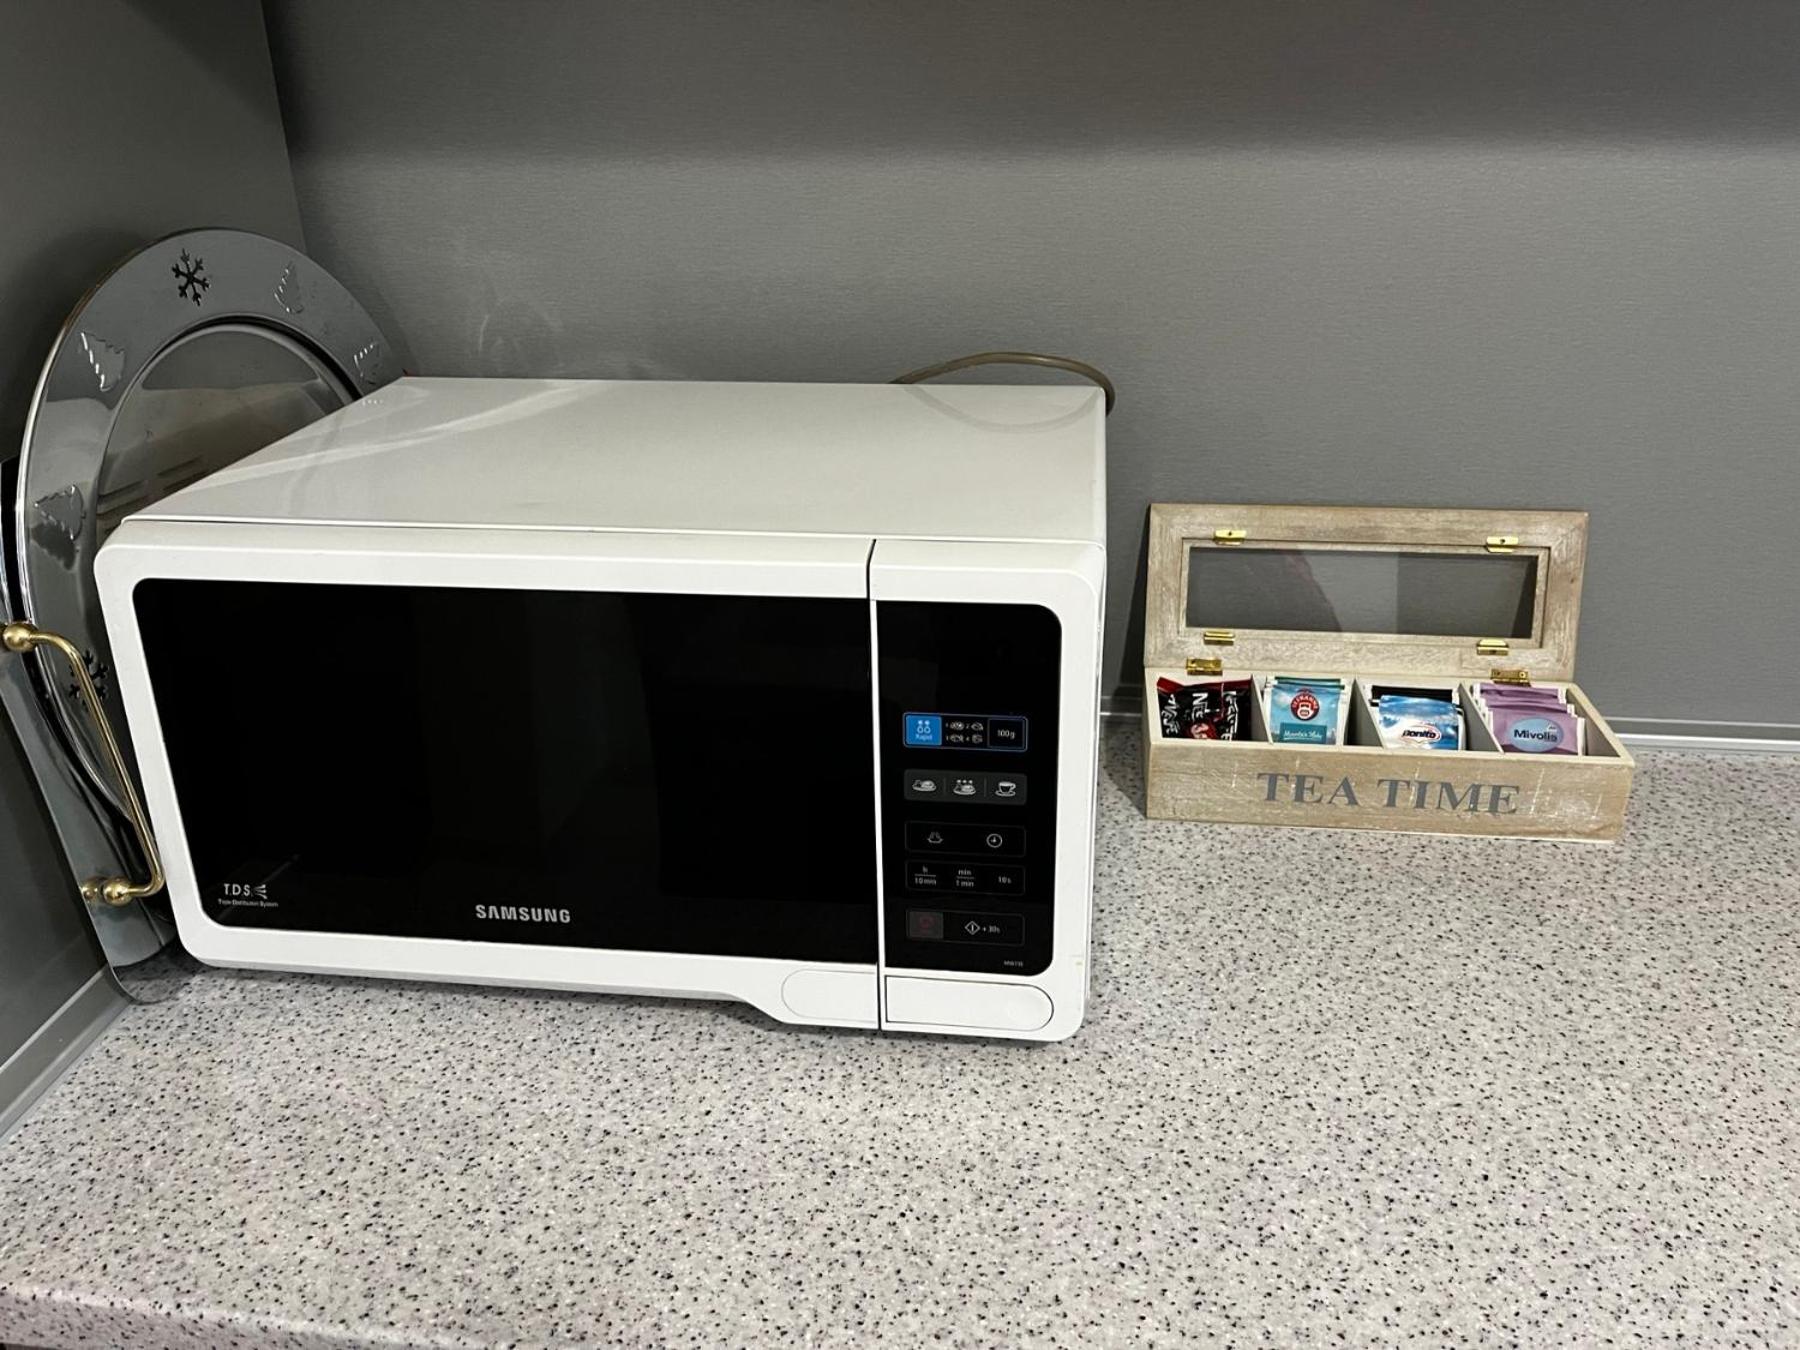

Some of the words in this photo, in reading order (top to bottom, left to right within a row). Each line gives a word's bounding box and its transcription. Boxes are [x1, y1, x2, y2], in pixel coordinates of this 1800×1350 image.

[1257, 773, 1359, 806] TEA
[1377, 778, 1520, 814] TIME
[475, 904, 571, 923] SAMSUNG
